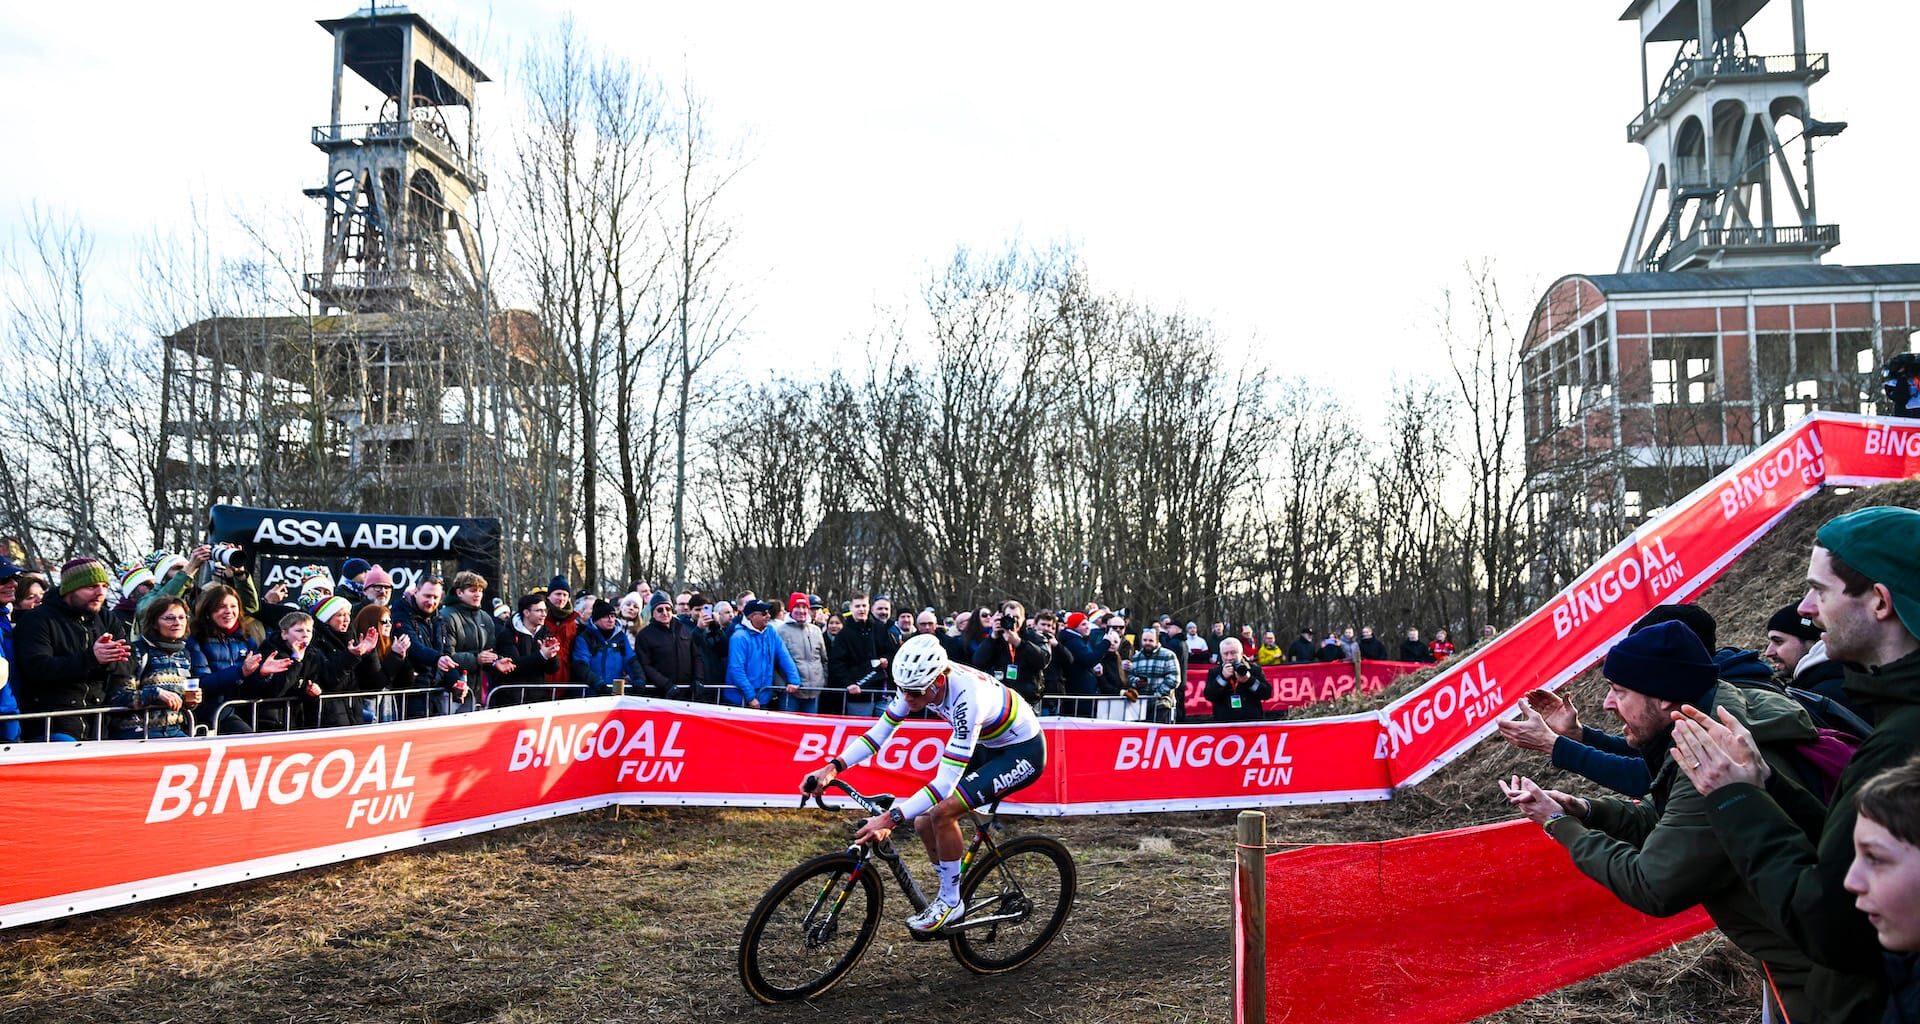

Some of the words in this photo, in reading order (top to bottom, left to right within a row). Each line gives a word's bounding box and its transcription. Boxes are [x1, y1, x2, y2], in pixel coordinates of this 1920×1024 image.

[253, 518, 345, 548] ASSA
[350, 523, 461, 550] ABLOY
[1553, 536, 1676, 640] B!NGOAL
[1650, 560, 1684, 596] FUN
[953, 702, 970, 740] Alpecin
[1464, 687, 1503, 727] FUN
[508, 716, 686, 772] B!NGOAL
[1114, 728, 1292, 770] B!NGOAL
[145, 742, 416, 824] B!NGOAL
[617, 760, 685, 783] FUN
[993, 759, 1032, 793] Alpecin
[1242, 767, 1293, 788] FUN
[345, 791, 414, 828] FUN
